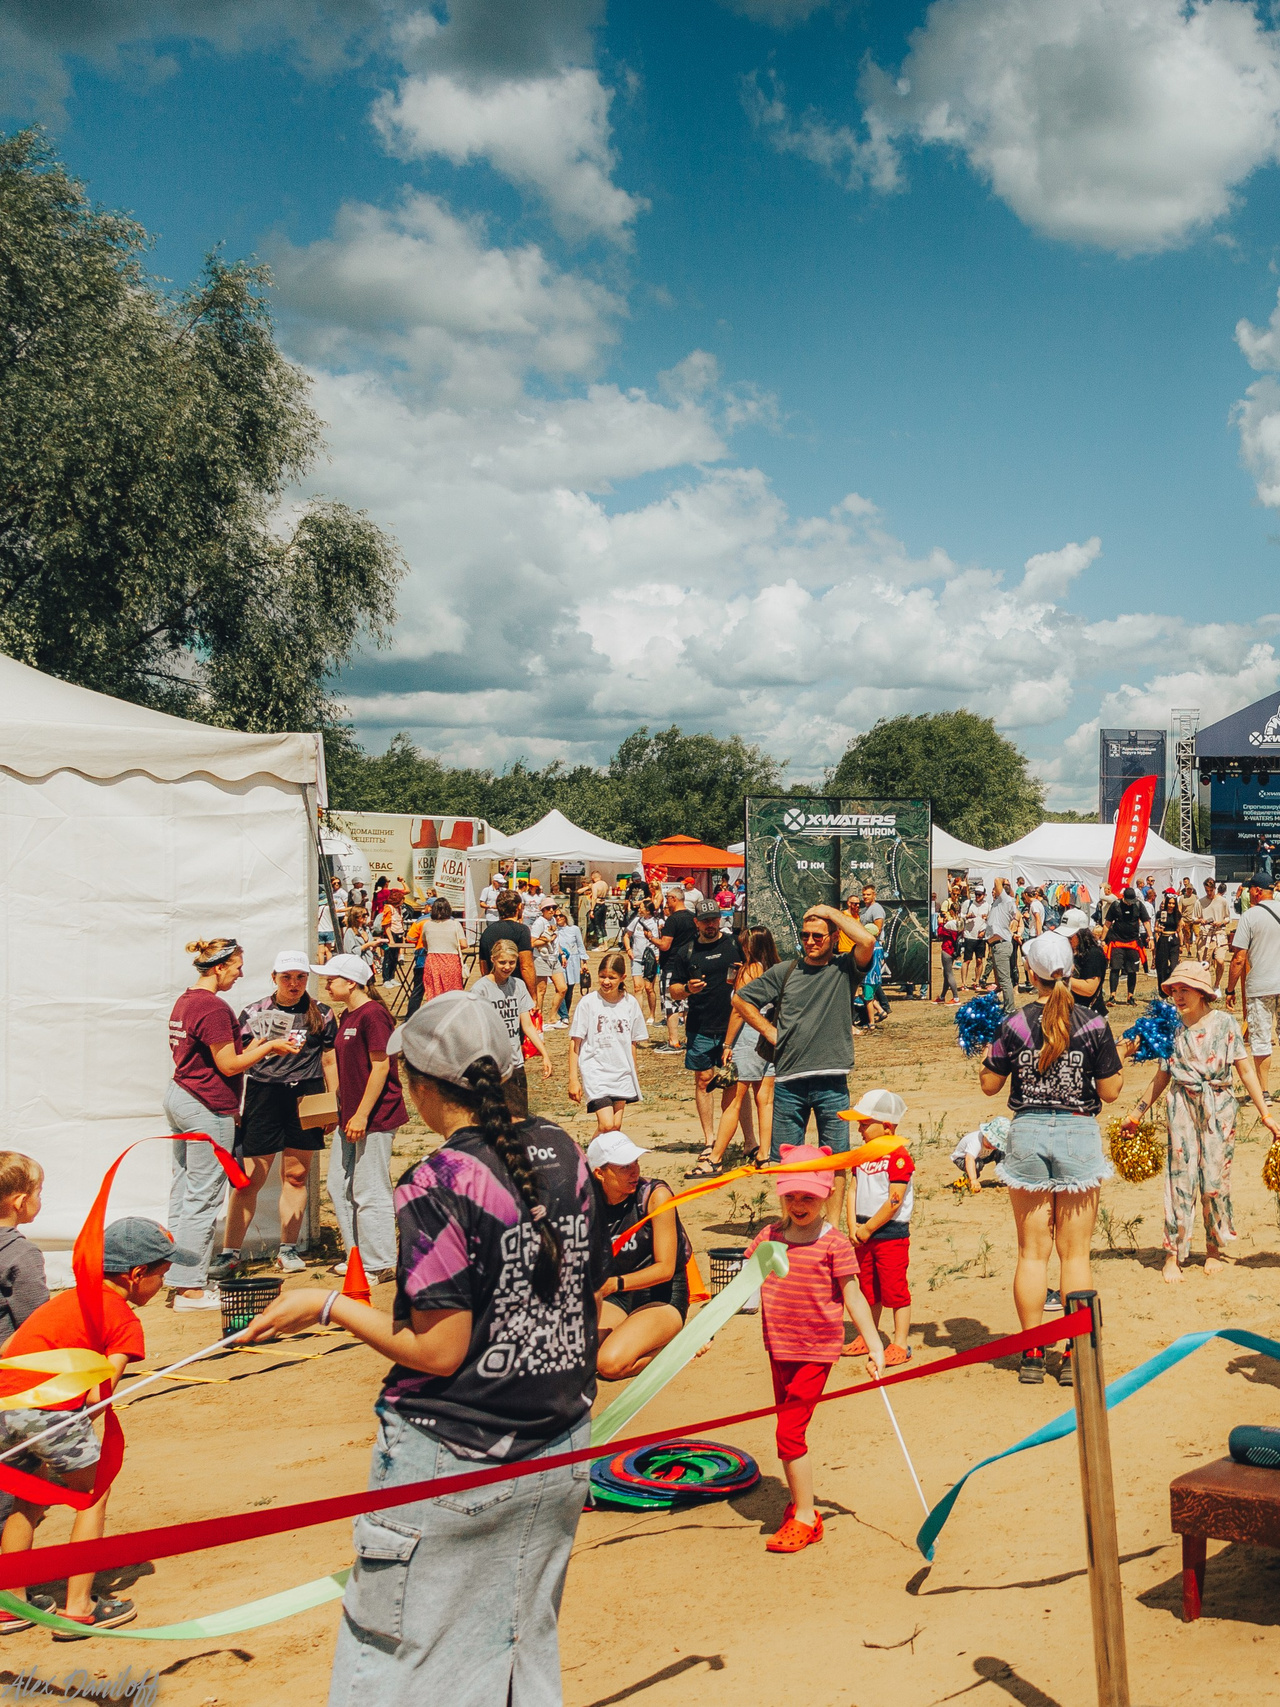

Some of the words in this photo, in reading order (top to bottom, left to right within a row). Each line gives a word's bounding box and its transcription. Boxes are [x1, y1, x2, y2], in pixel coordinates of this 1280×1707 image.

[860, 828, 896, 836] MUROM
[369, 862, 393, 870] КВАС
[417, 857, 438, 868] КВА
[797, 861, 809, 869] 10
[850, 861, 858, 869] 5
[442, 859, 467, 876] КВА
[701, 902, 725, 912] 88
